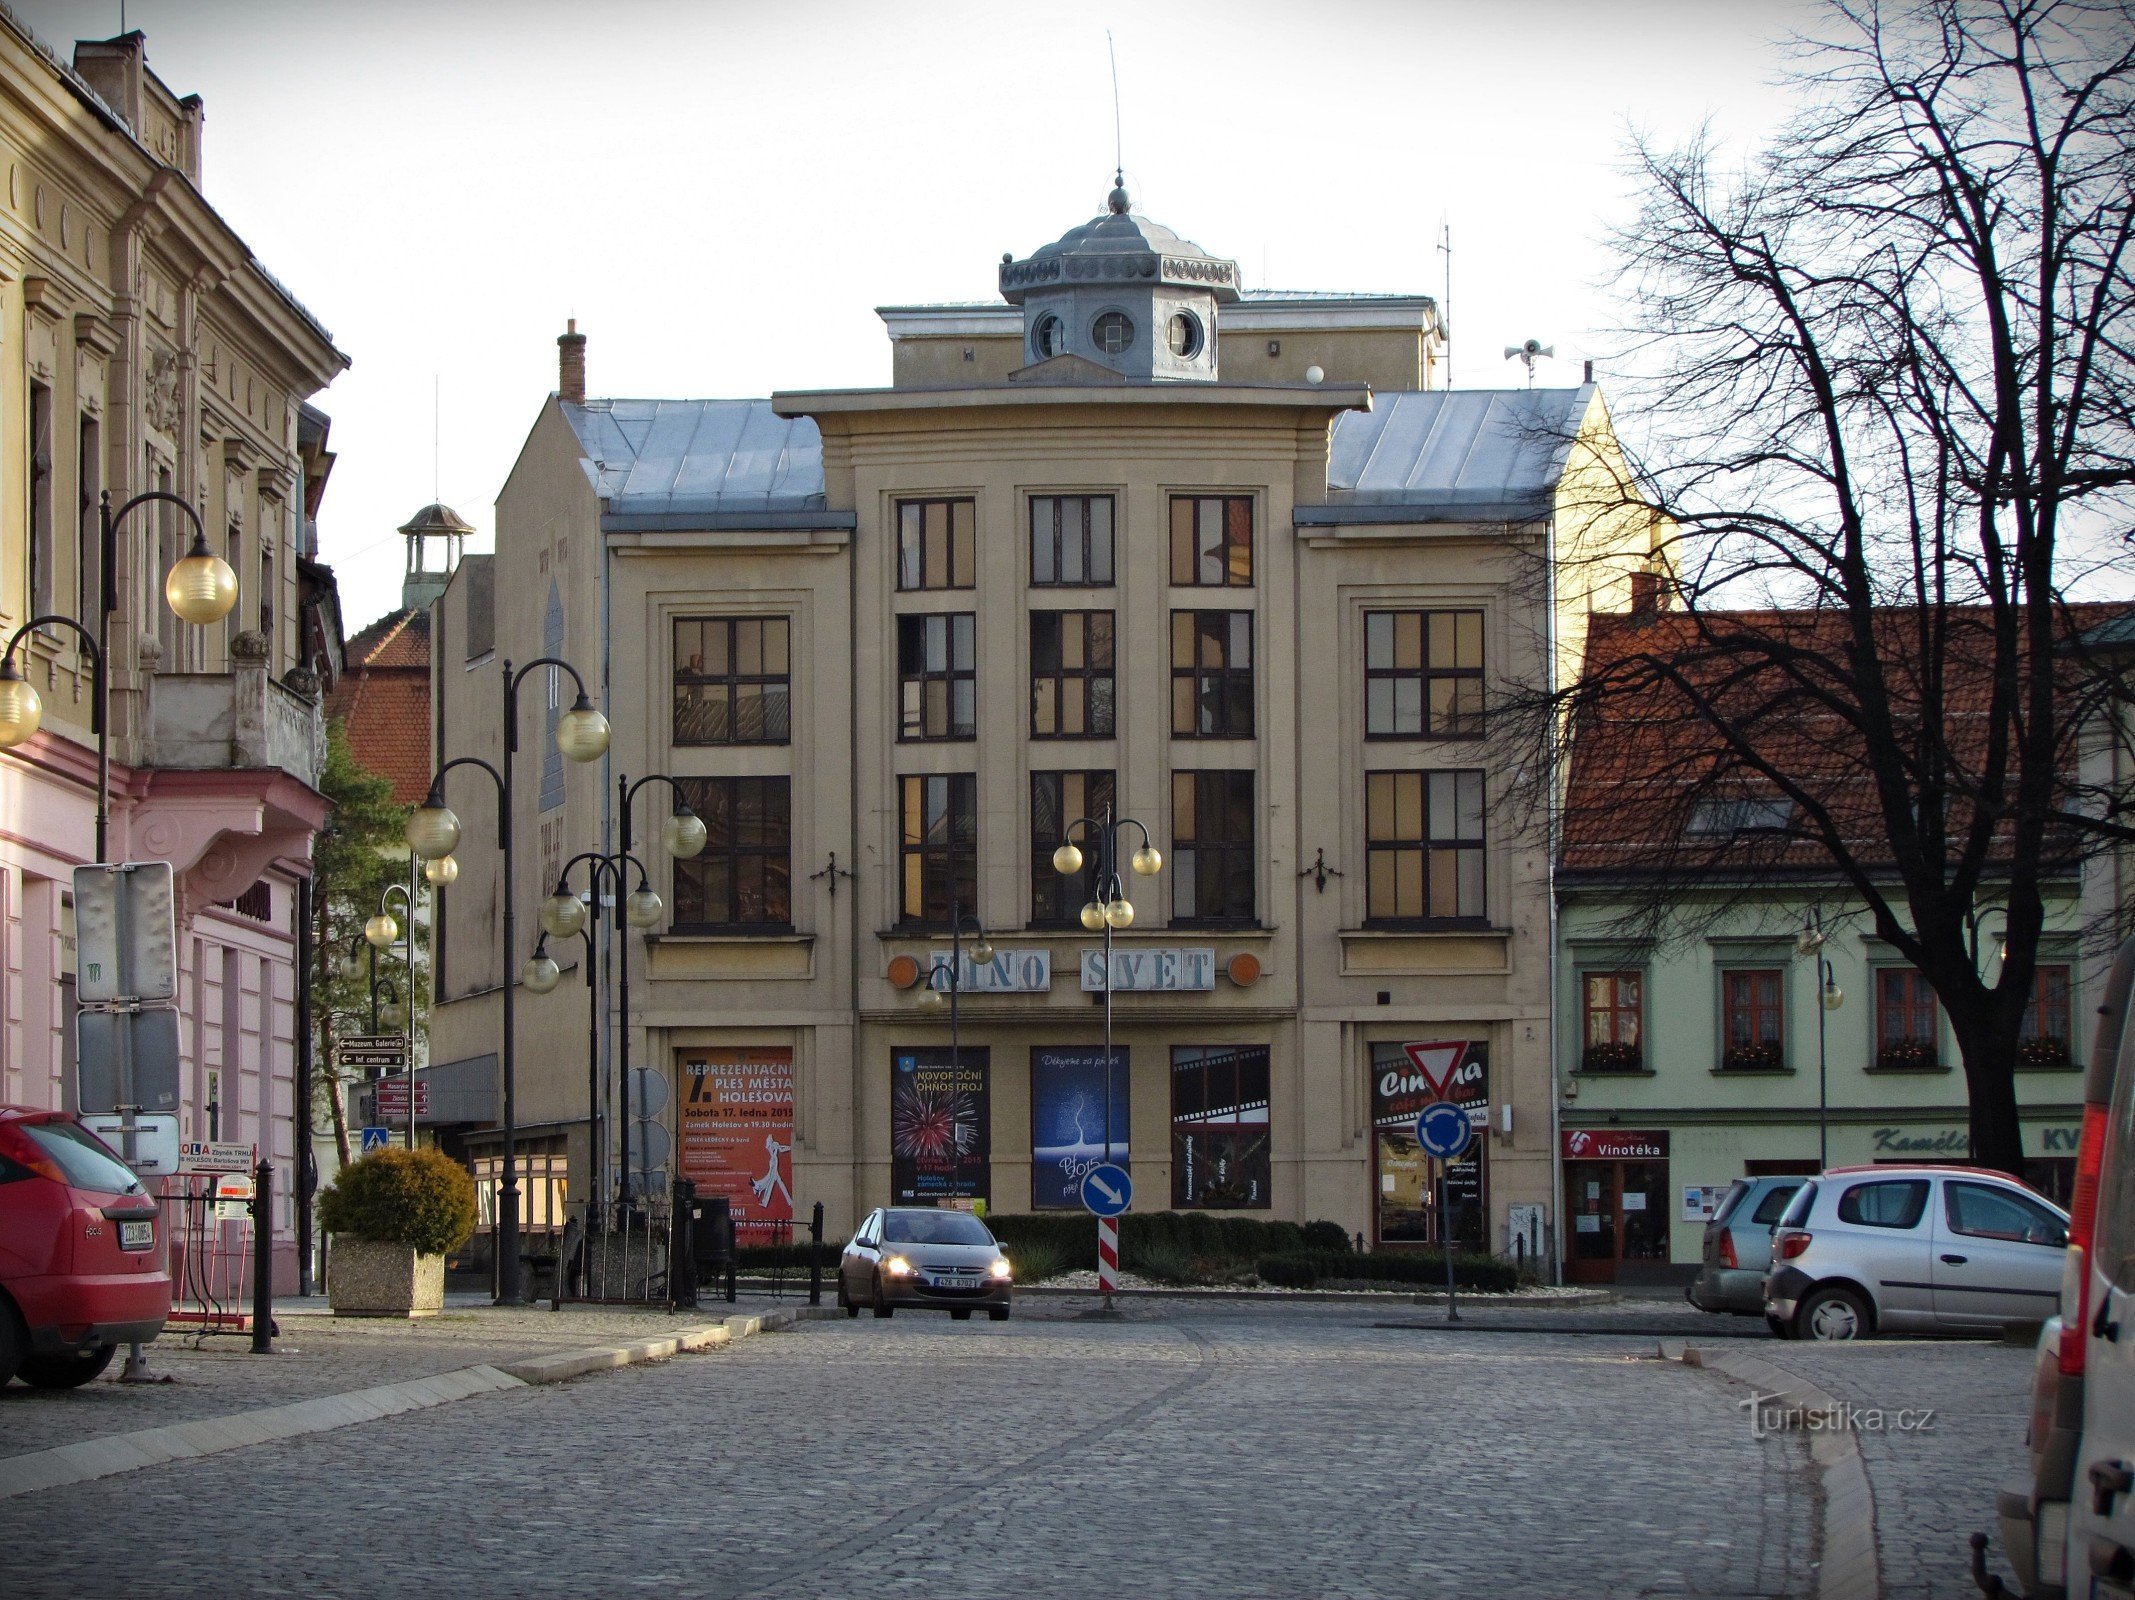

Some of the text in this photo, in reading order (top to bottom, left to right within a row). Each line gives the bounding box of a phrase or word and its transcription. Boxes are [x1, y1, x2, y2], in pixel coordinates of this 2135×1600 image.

[934, 951, 1044, 990] KINO
[686, 1063, 793, 1075] REPREZENTAČNÍ
[917, 1070, 982, 1080] NOVOROČNÍ
[715, 1075, 793, 1089] PLES MĚSTA
[719, 1089, 793, 1103] HOLEŠOVA
[685, 1108, 793, 1117] Sobota 17. ledna 2015
[1598, 1144, 1660, 1155] Vinotéka
